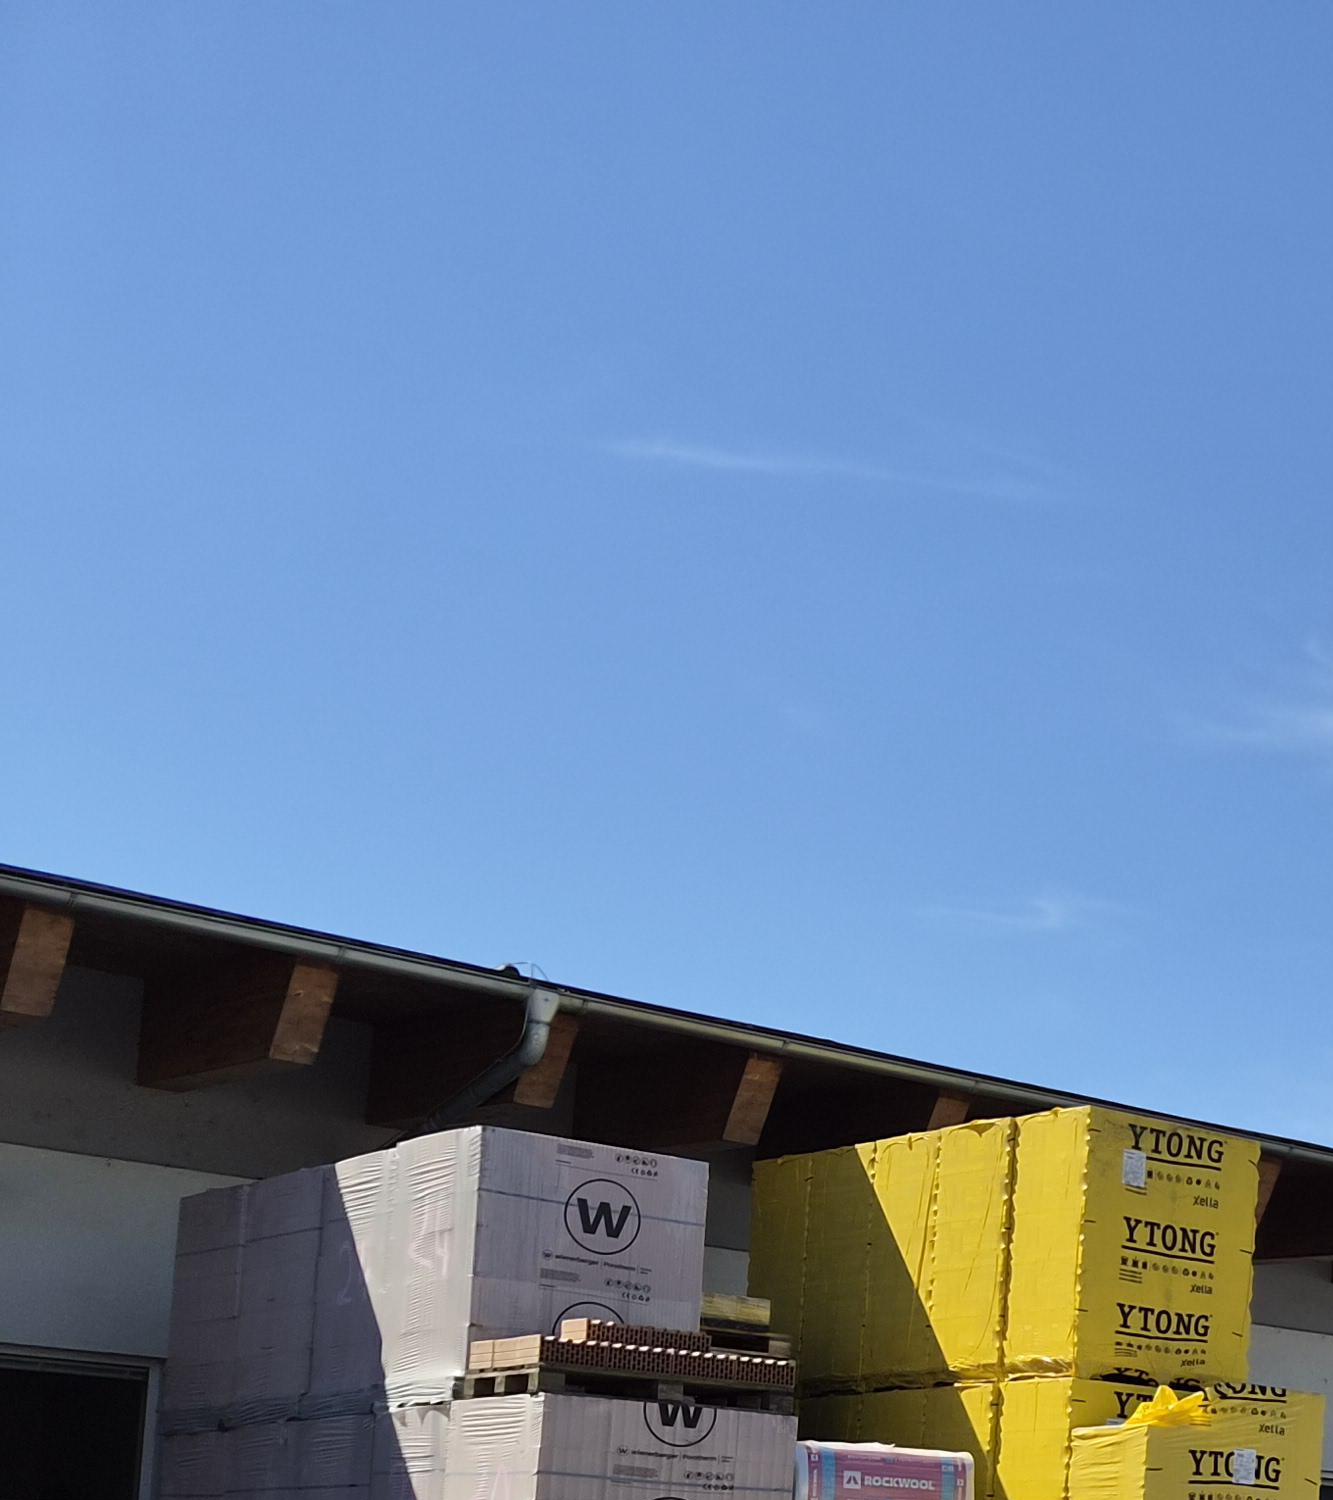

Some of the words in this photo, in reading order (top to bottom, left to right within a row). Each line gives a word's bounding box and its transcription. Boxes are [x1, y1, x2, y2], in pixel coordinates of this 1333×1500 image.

[1128, 1123, 1225, 1164] YTONG
[1123, 1216, 1216, 1258] YTONG
[1116, 1302, 1211, 1337] YTONG
[864, 1475, 936, 1491] ROCKWOOL
